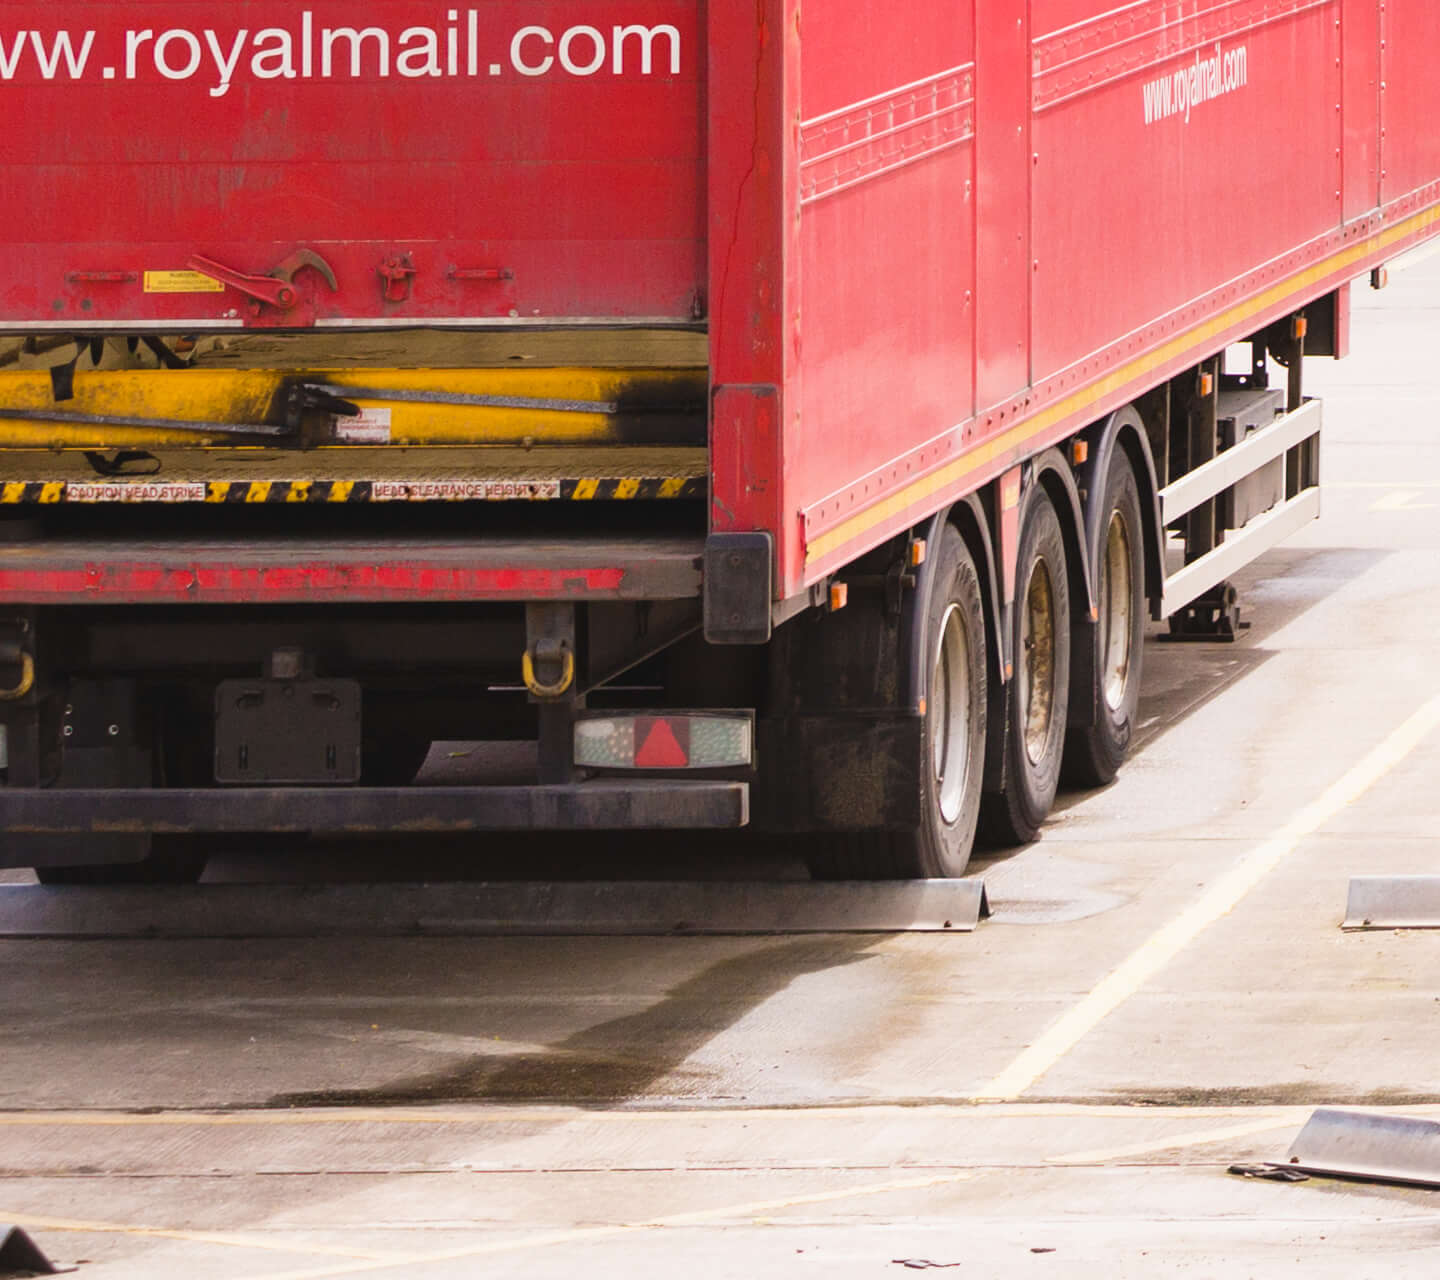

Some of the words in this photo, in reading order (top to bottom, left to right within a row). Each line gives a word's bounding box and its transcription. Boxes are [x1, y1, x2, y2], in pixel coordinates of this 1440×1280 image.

[1143, 40, 1248, 125] www.royalmail.com
[69, 487, 121, 498] CAUTION
[126, 487, 157, 498] HEAD
[162, 487, 203, 498] STRIKE
